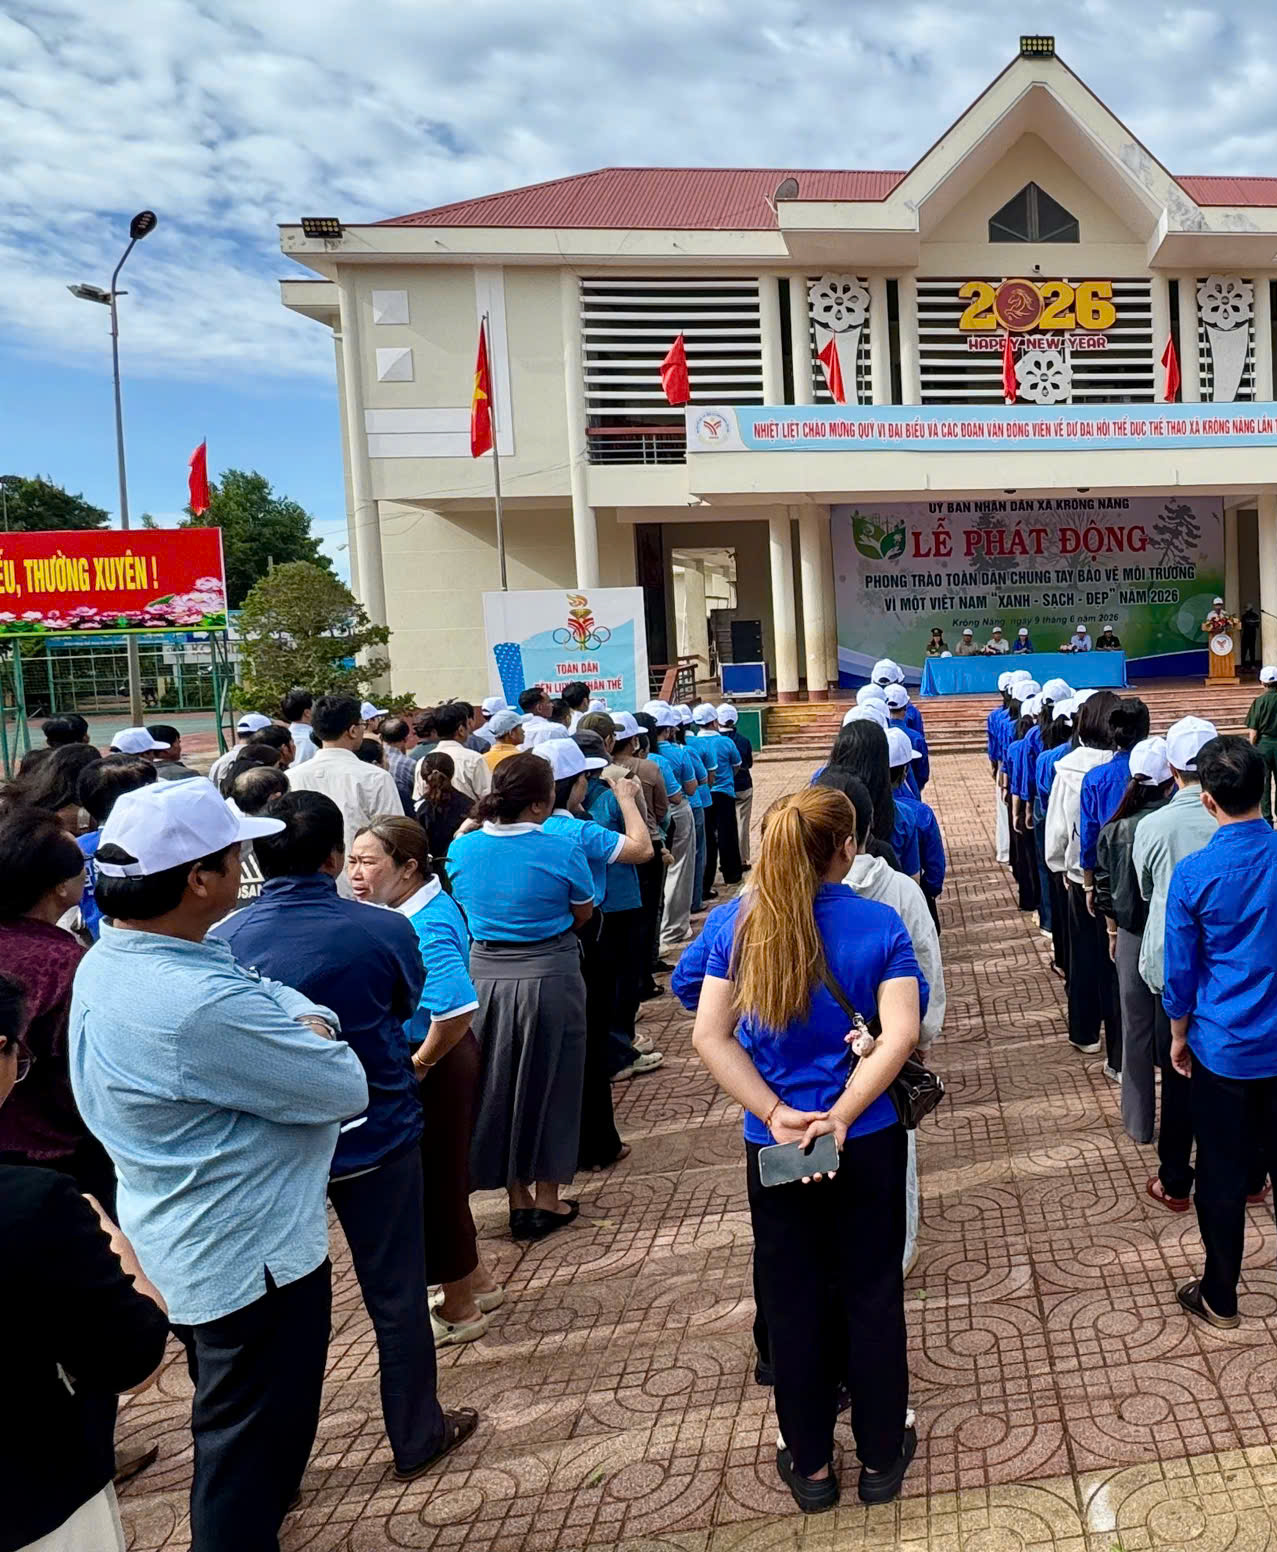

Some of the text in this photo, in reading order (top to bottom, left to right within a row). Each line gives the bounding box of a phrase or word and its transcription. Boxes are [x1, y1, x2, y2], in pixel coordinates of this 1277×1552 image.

[958, 278, 1117, 332] 2026
[968, 336, 1108, 351] HAPPY NEW YEAR
[754, 420, 779, 442] NHIỆT
[782, 420, 800, 442] LIỆT
[803, 420, 826, 438] CHÀO
[829, 419, 855, 438] MỪNG
[858, 420, 874, 439] QUÝ
[877, 422, 887, 442] VỊ
[888, 423, 904, 442] ĐẠI
[905, 417, 925, 438] BIỂU
[927, 420, 939, 438] VÀ
[941, 419, 959, 438] CÁC
[961, 419, 984, 438] ĐOÀN
[986, 418, 1004, 441] VẬN
[1006, 418, 1029, 441] ĐỘNG
[1032, 418, 1051, 438] VIÊN
[1053, 417, 1064, 437] VỀ
[1066, 420, 1079, 441] DỰ
[1080, 421, 1094, 440] ĐẠI
[1096, 418, 1110, 440] HỘI
[1112, 416, 1128, 436] THỂ
[1130, 420, 1147, 439] DỤC
[1149, 415, 1163, 436] THỂ
[1166, 419, 1186, 436] THAO
[1189, 416, 1200, 435] XÃ
[1202, 416, 1230, 435] KRÔNG
[1232, 416, 1254, 434] NĂNG
[1257, 413, 1273, 434] LẦN
[947, 502, 971, 513] BAN
[912, 517, 1150, 562] LỄ PHÁT ĐỘNG
[24, 550, 90, 593] THƯỜNG
[93, 549, 148, 591] XUYÊN
[152, 555, 159, 590] !
[865, 564, 1194, 589] PHONG TRÀO TOÀN DÂN CHUNG TAY BẢO VỆ MÔI TRƯỜNG
[885, 596, 896, 612] VÌ
[900, 595, 926, 614] MỘT
[931, 594, 956, 614] VIỆT
[959, 596, 987, 609] NAM
[1042, 592, 1074, 609] SẠCH
[1119, 588, 1146, 604] NĂM
[1150, 589, 1178, 603] 2026
[952, 618, 979, 627] Krông
[1011, 616, 1032, 627] ngày
[1034, 616, 1040, 625] 9
[1042, 614, 1067, 626] tháng
[1077, 613, 1096, 623] năm
[1098, 613, 1119, 622] 2026
[556, 660, 599, 675] TOÀN DÂN
[607, 674, 622, 689] THỂ
